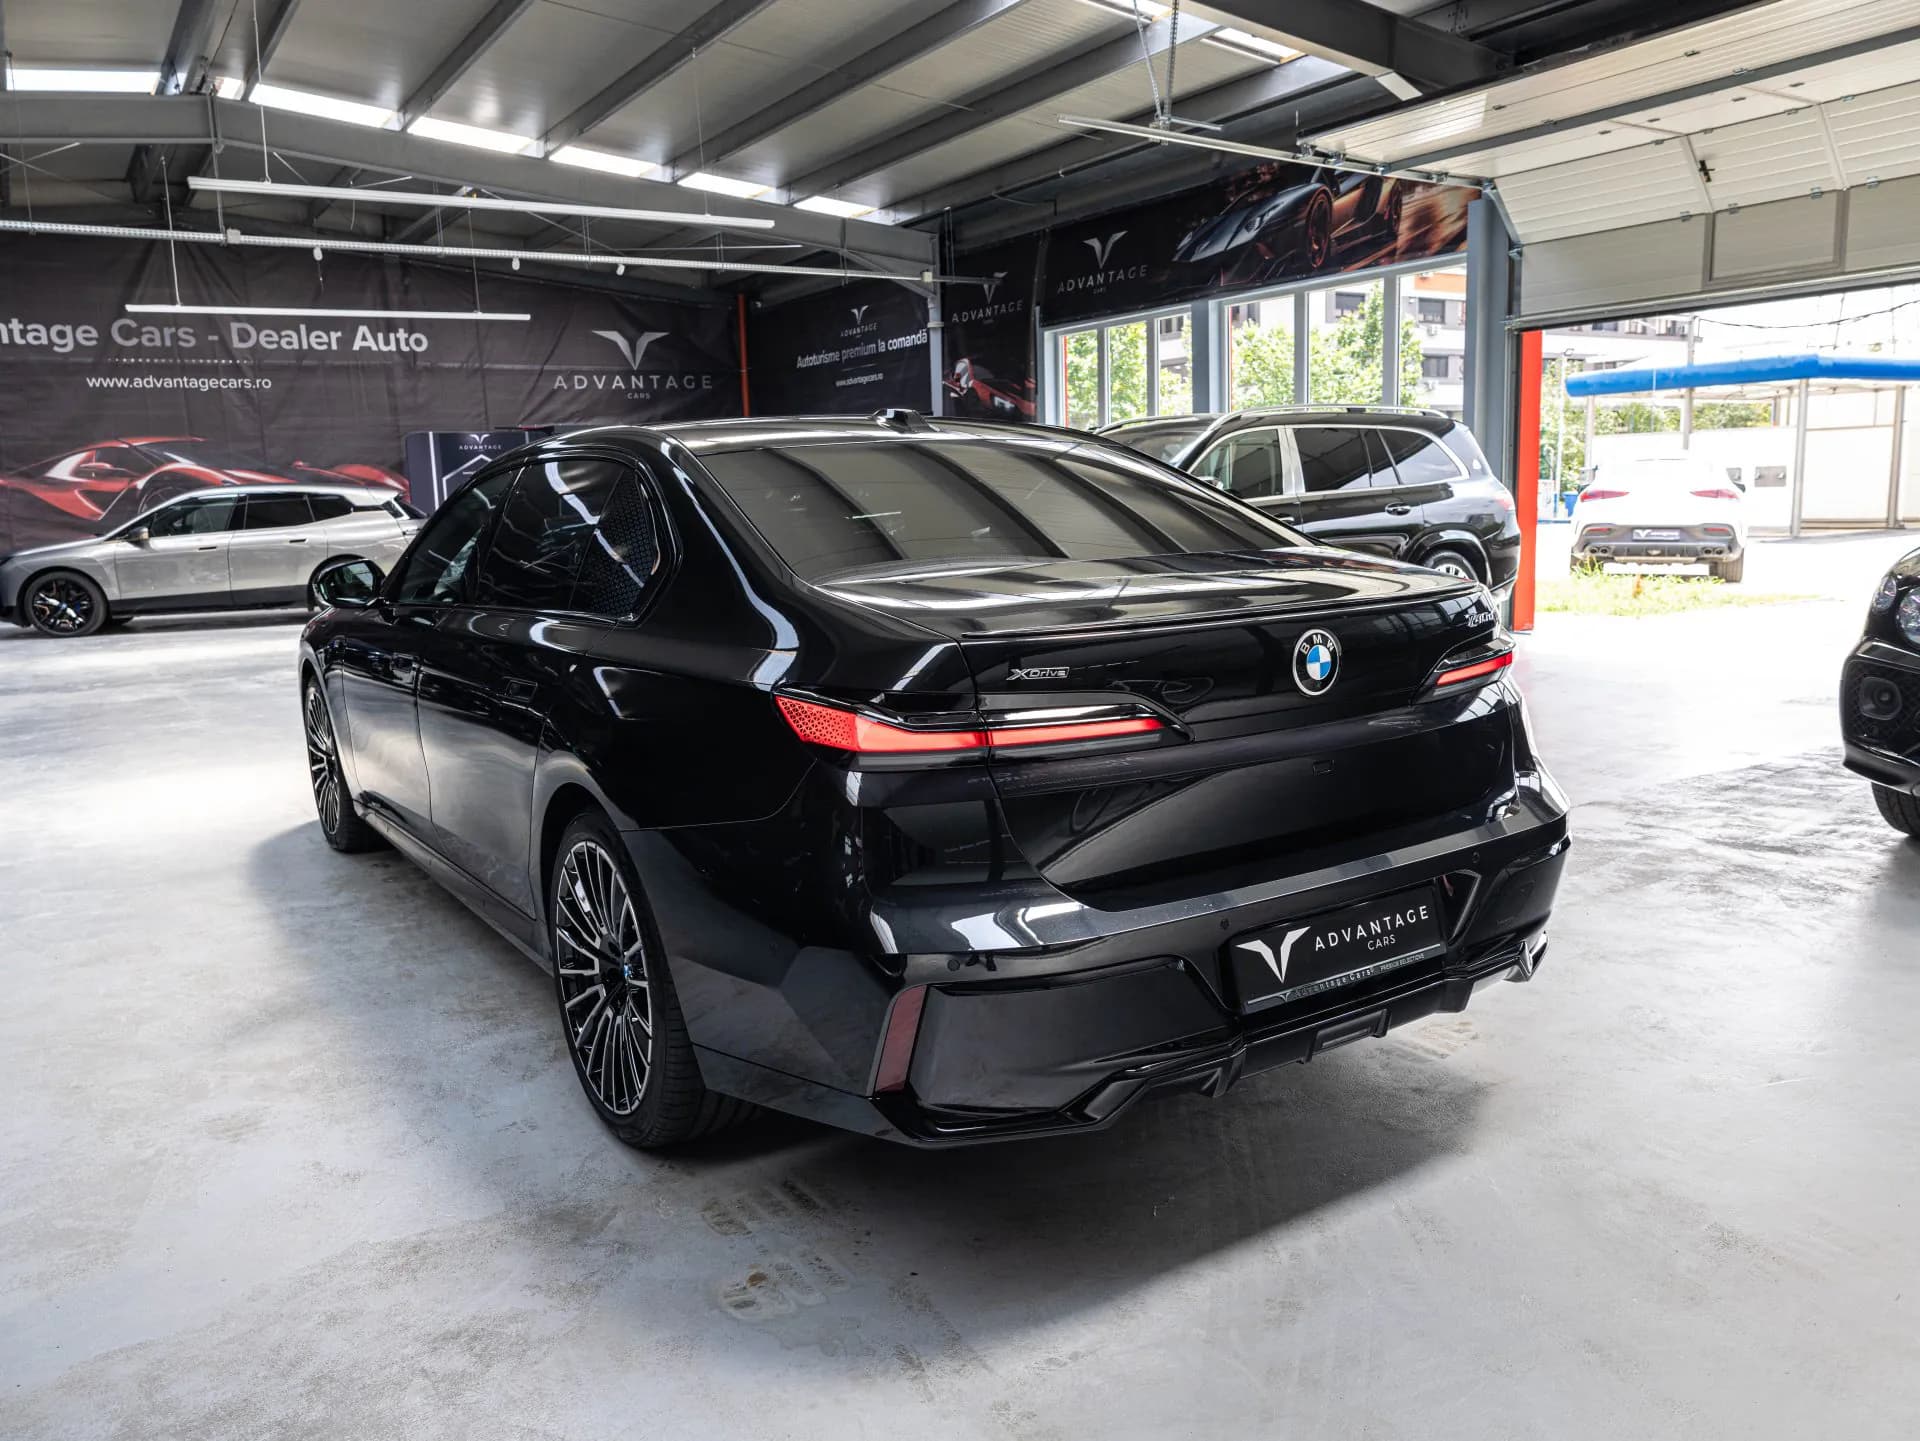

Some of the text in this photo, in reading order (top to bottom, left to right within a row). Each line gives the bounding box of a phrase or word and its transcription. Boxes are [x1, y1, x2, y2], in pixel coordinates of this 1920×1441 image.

[1056, 264, 1149, 294] ADVANTAGE
[951, 300, 1023, 322] ADVANTAGE
[110, 318, 196, 348] Cars
[230, 322, 342, 351] Dealer
[352, 325, 429, 353] Auto
[840, 322, 877, 337] ADVANTAGE
[796, 350, 840, 369] Autoturisme
[841, 342, 877, 364] premium
[878, 339, 886, 353] la
[86, 374, 272, 392] www.advantagecars.ro
[553, 374, 713, 390] ADVANTAGE
[627, 392, 651, 400] CARS
[1300, 634, 1335, 654] BMW
[1315, 905, 1430, 951] ADVANTAGE
[1367, 934, 1396, 951] CARS
